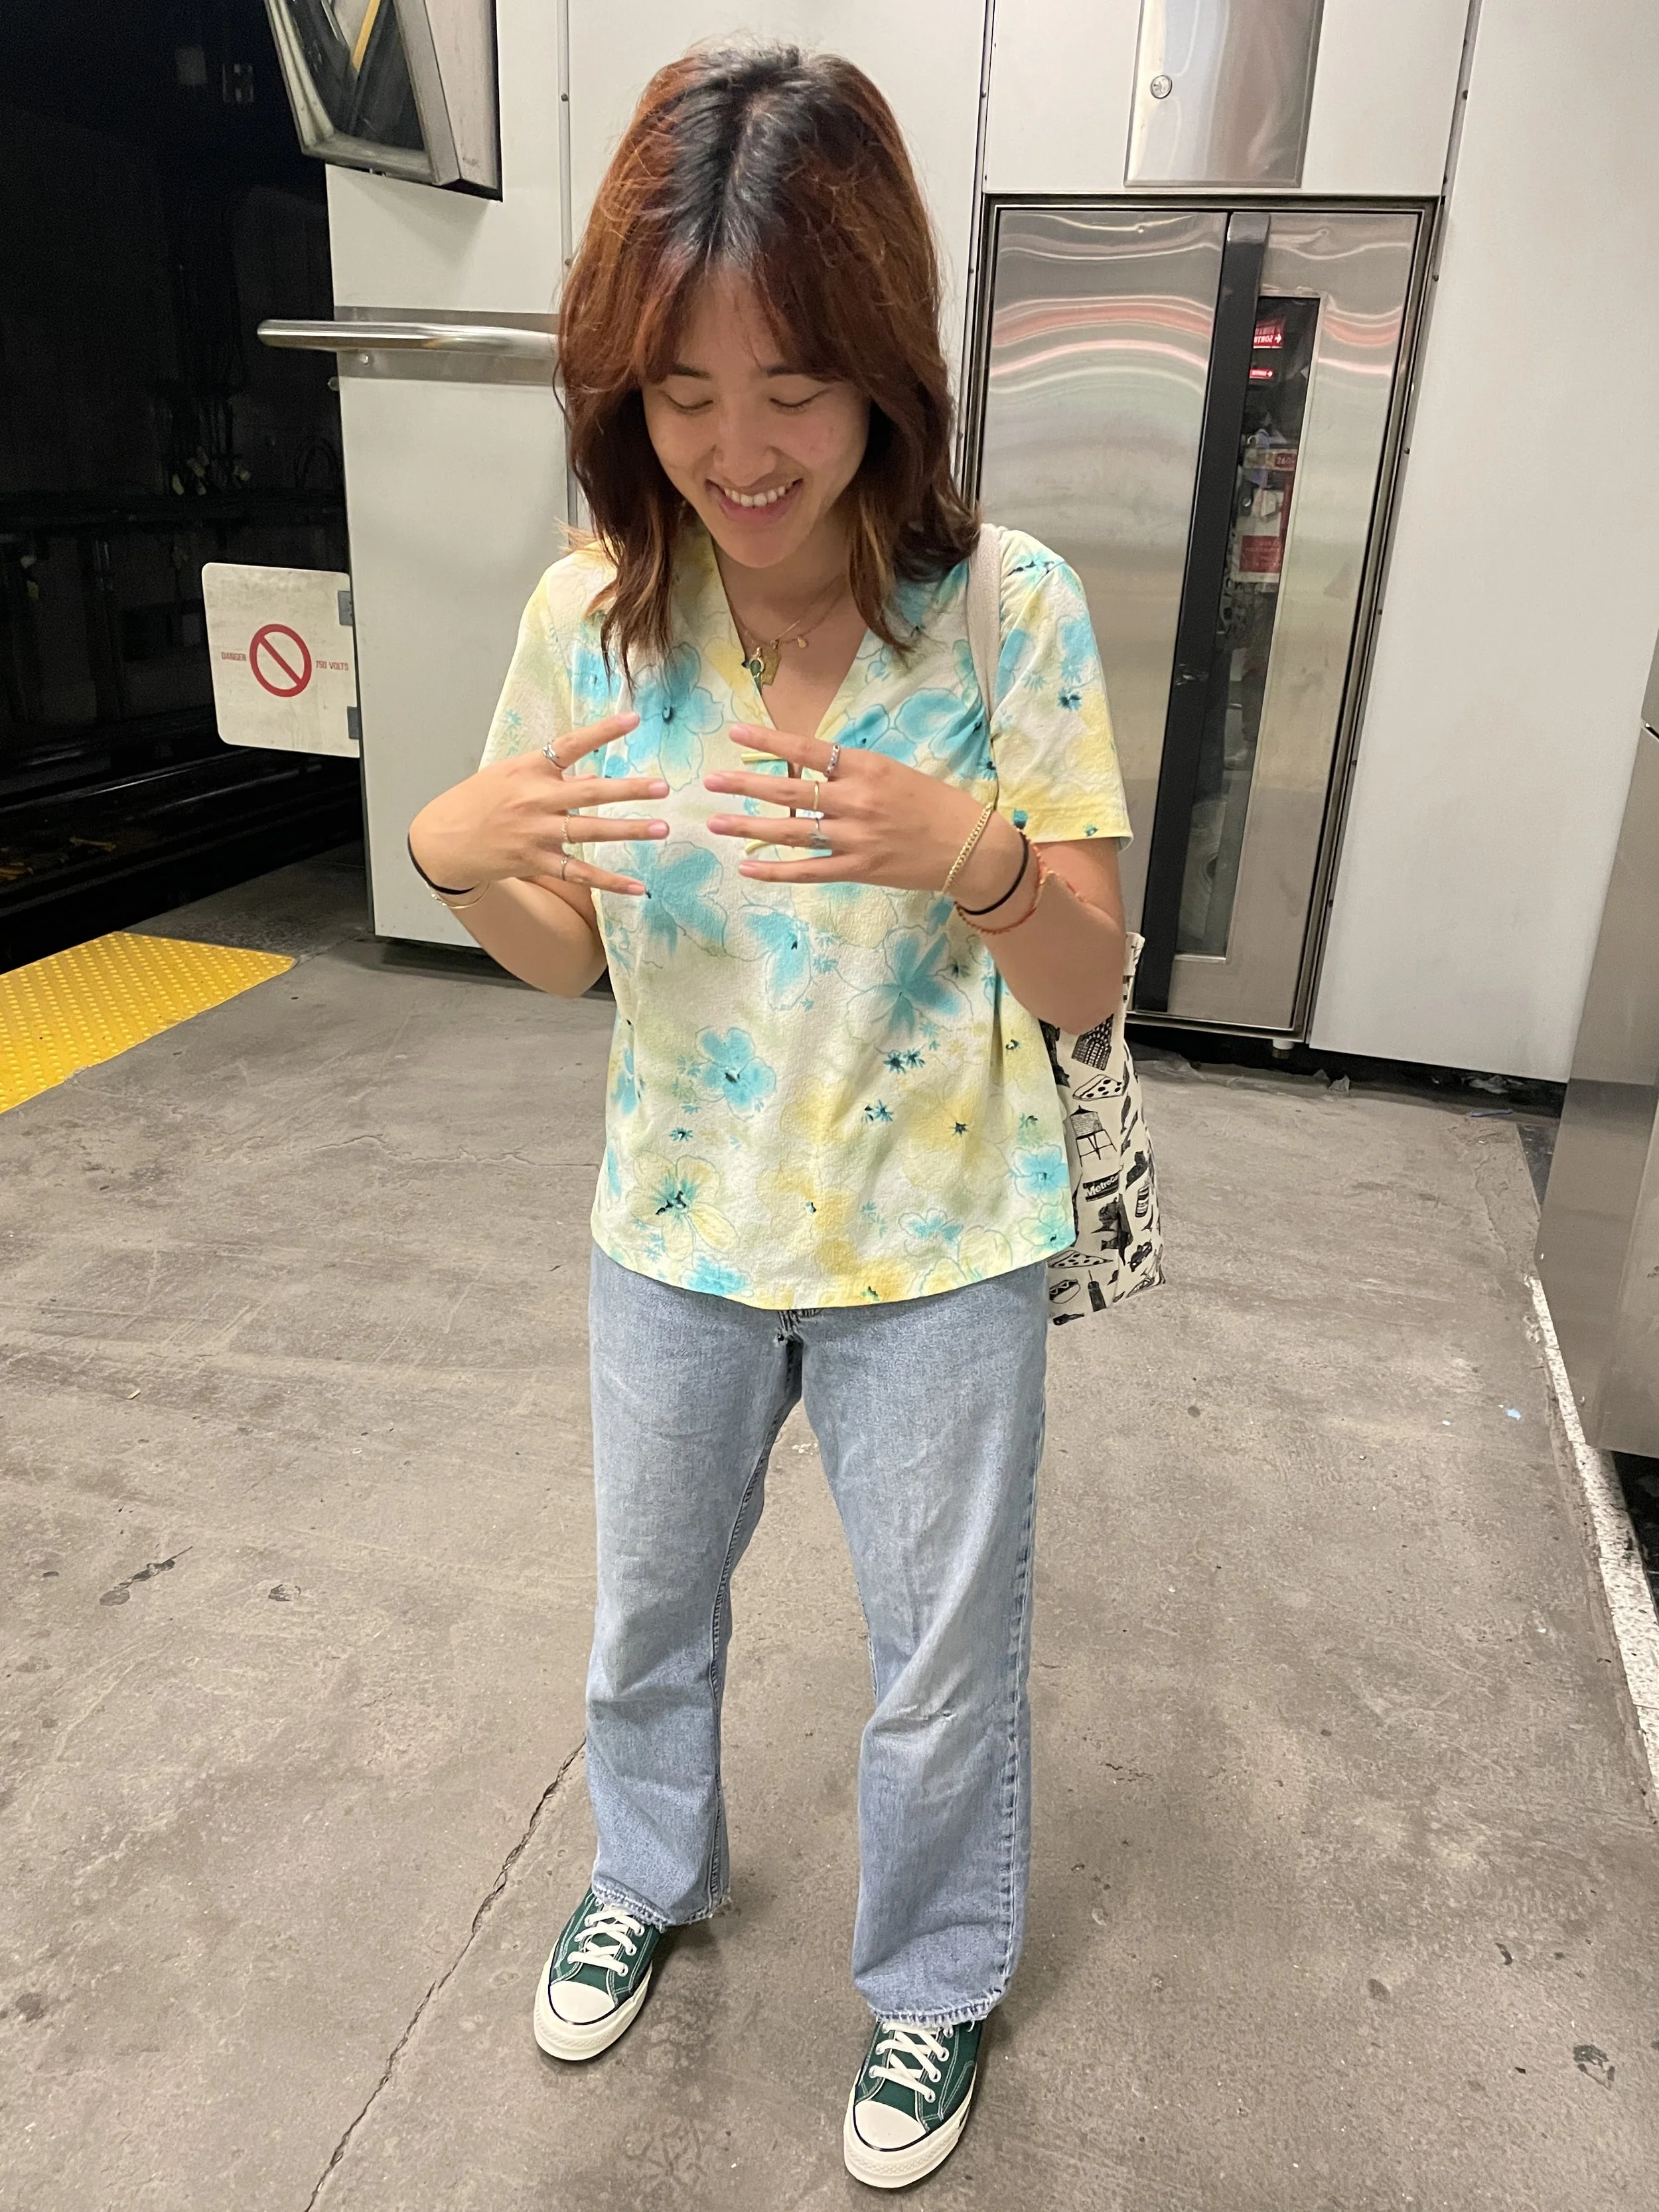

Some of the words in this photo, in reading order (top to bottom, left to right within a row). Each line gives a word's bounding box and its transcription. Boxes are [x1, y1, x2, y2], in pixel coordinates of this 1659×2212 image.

[221, 652, 247, 662] DANGER
[316, 660, 327, 669] 750
[328, 662, 349, 671] VOLTS
